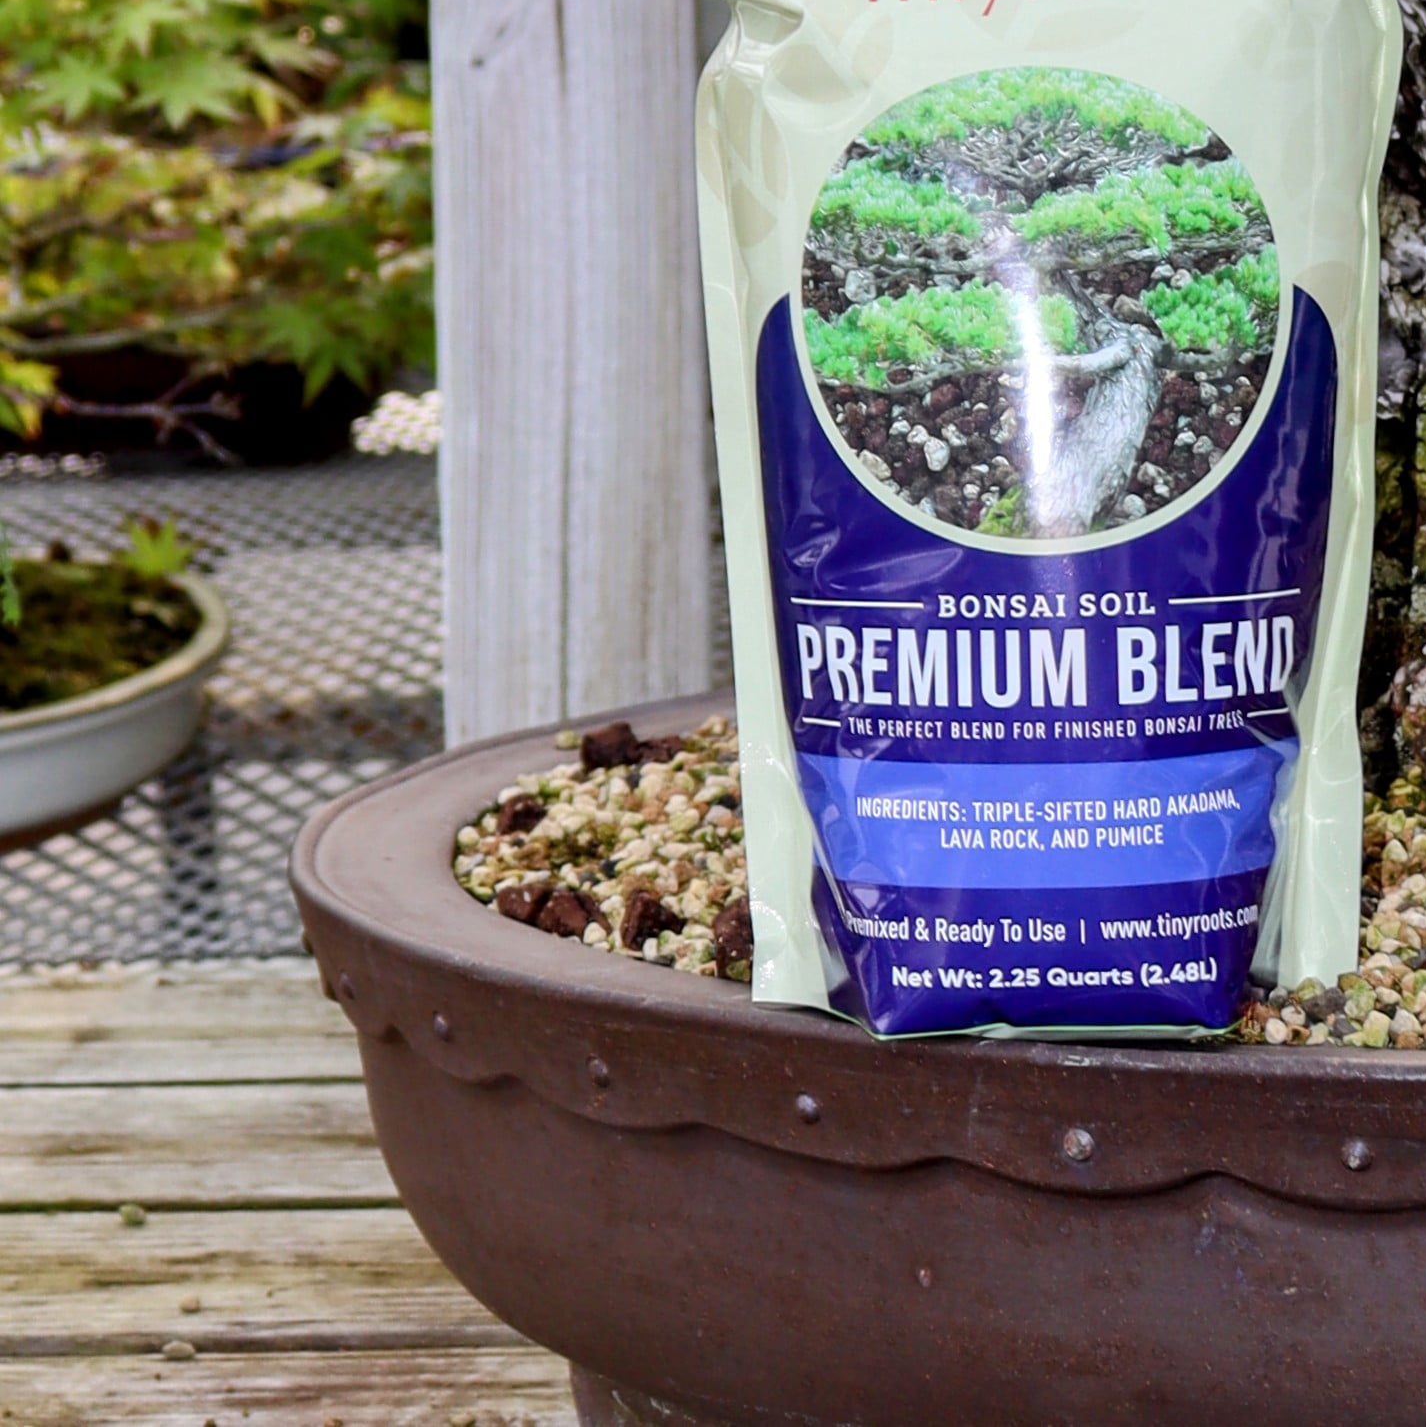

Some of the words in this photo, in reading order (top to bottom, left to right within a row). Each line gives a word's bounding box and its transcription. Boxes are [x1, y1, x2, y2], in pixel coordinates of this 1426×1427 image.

[937, 594, 1066, 619] BONSAI
[1078, 591, 1156, 617] SOIL
[796, 623, 1088, 708] PREMIUM
[1116, 615, 1295, 706] BLEND
[847, 716, 874, 736] THE
[878, 719, 943, 739] PERFECT
[950, 721, 1006, 741] BLEND
[1012, 722, 1047, 741] FOR
[1053, 720, 1137, 740] FINISHED
[1144, 715, 1202, 737] BONSAI
[1208, 709, 1245, 731] TREES
[856, 796, 967, 822] INGREDIENTS:
[972, 799, 1107, 823] TRIPLE-SIFTED
[1113, 797, 1161, 819] HARD
[1166, 788, 1241, 817] AKADAMA,
[940, 827, 984, 850] LAVA
[990, 828, 1045, 852] ROCK,
[1050, 827, 1090, 849] AND
[1096, 824, 1164, 848] PUMICE
[915, 917, 930, 941] &
[935, 918, 995, 947] Ready
[999, 918, 1024, 942] To
[1028, 918, 1066, 941] Use
[891, 966, 933, 989] Net
[938, 968, 983, 989] Wt:
[989, 967, 1041, 988] 2.25
[1046, 967, 1134, 988] Quarts
[1140, 957, 1218, 988] (2.48L)
